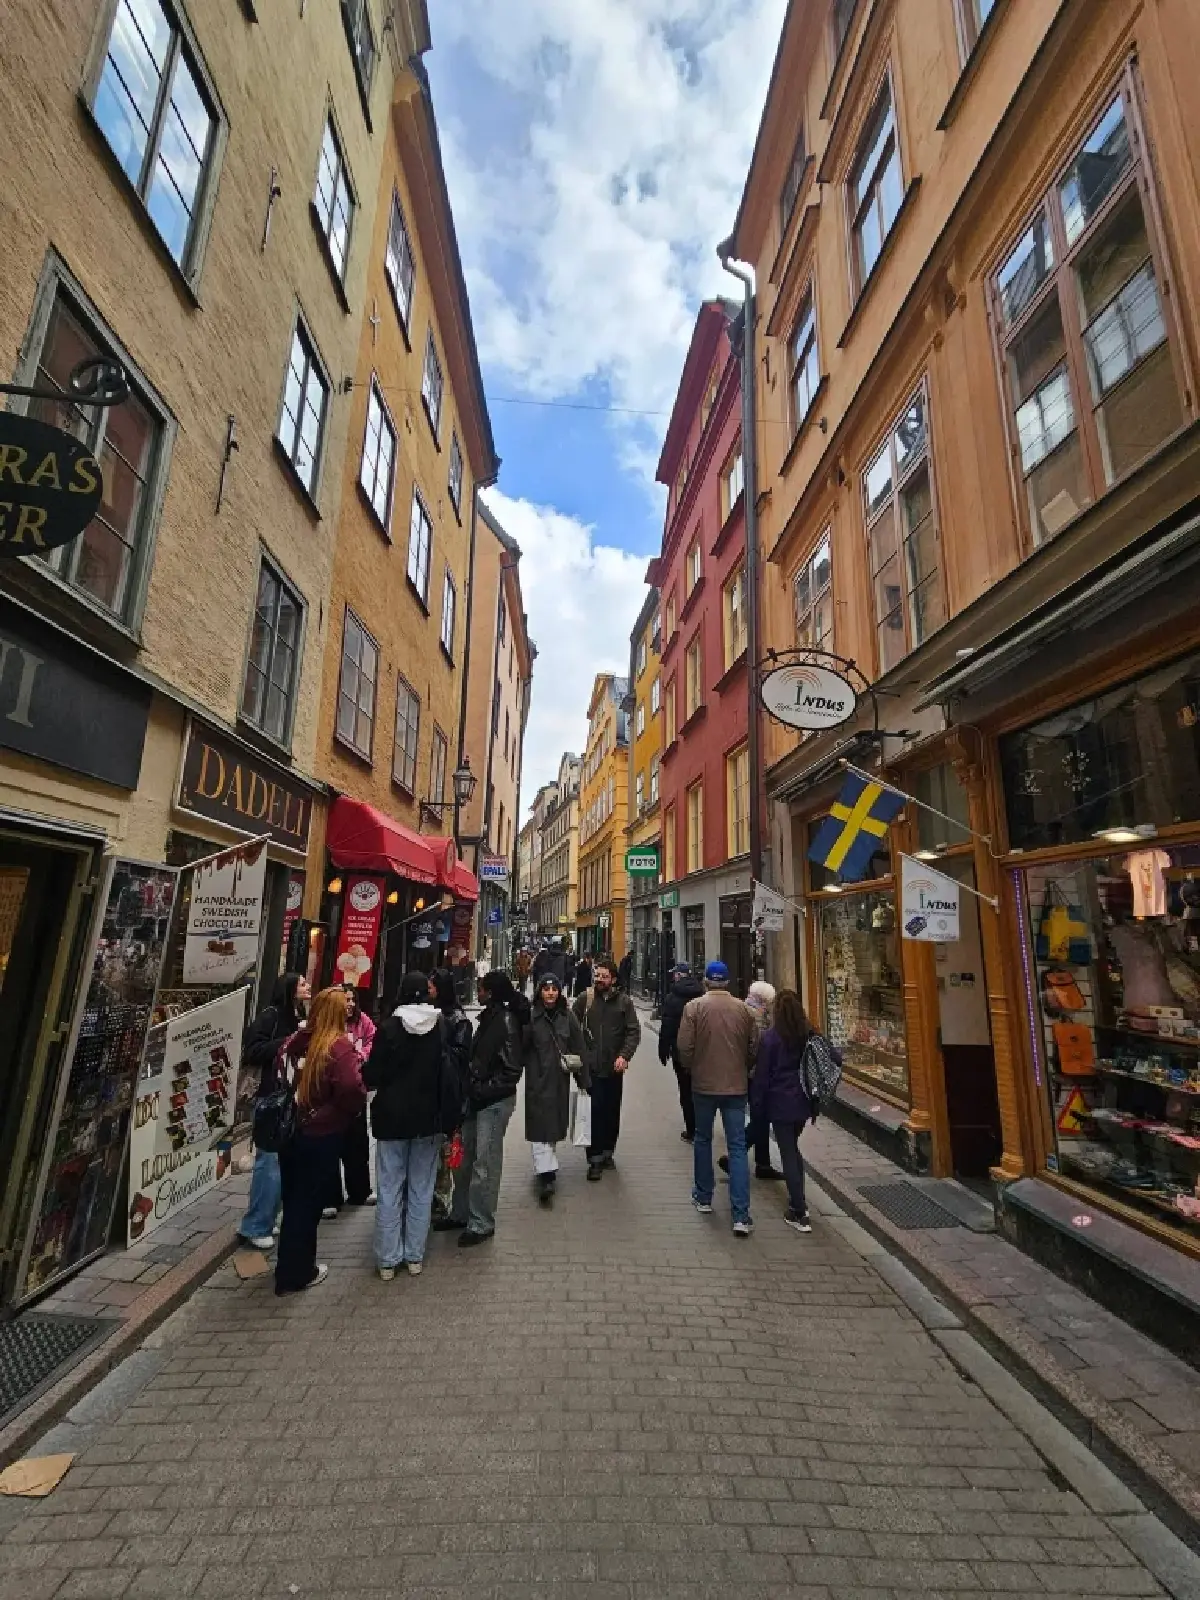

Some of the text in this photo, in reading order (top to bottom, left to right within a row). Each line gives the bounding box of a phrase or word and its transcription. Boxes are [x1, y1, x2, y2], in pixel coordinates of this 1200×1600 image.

[195, 743, 305, 836] DADELI
[629, 857, 656, 867] FOTO
[194, 895, 259, 907] HANDMADE
[201, 906, 249, 917] SWEDISH
[193, 918, 256, 929] CHOCOLATE
